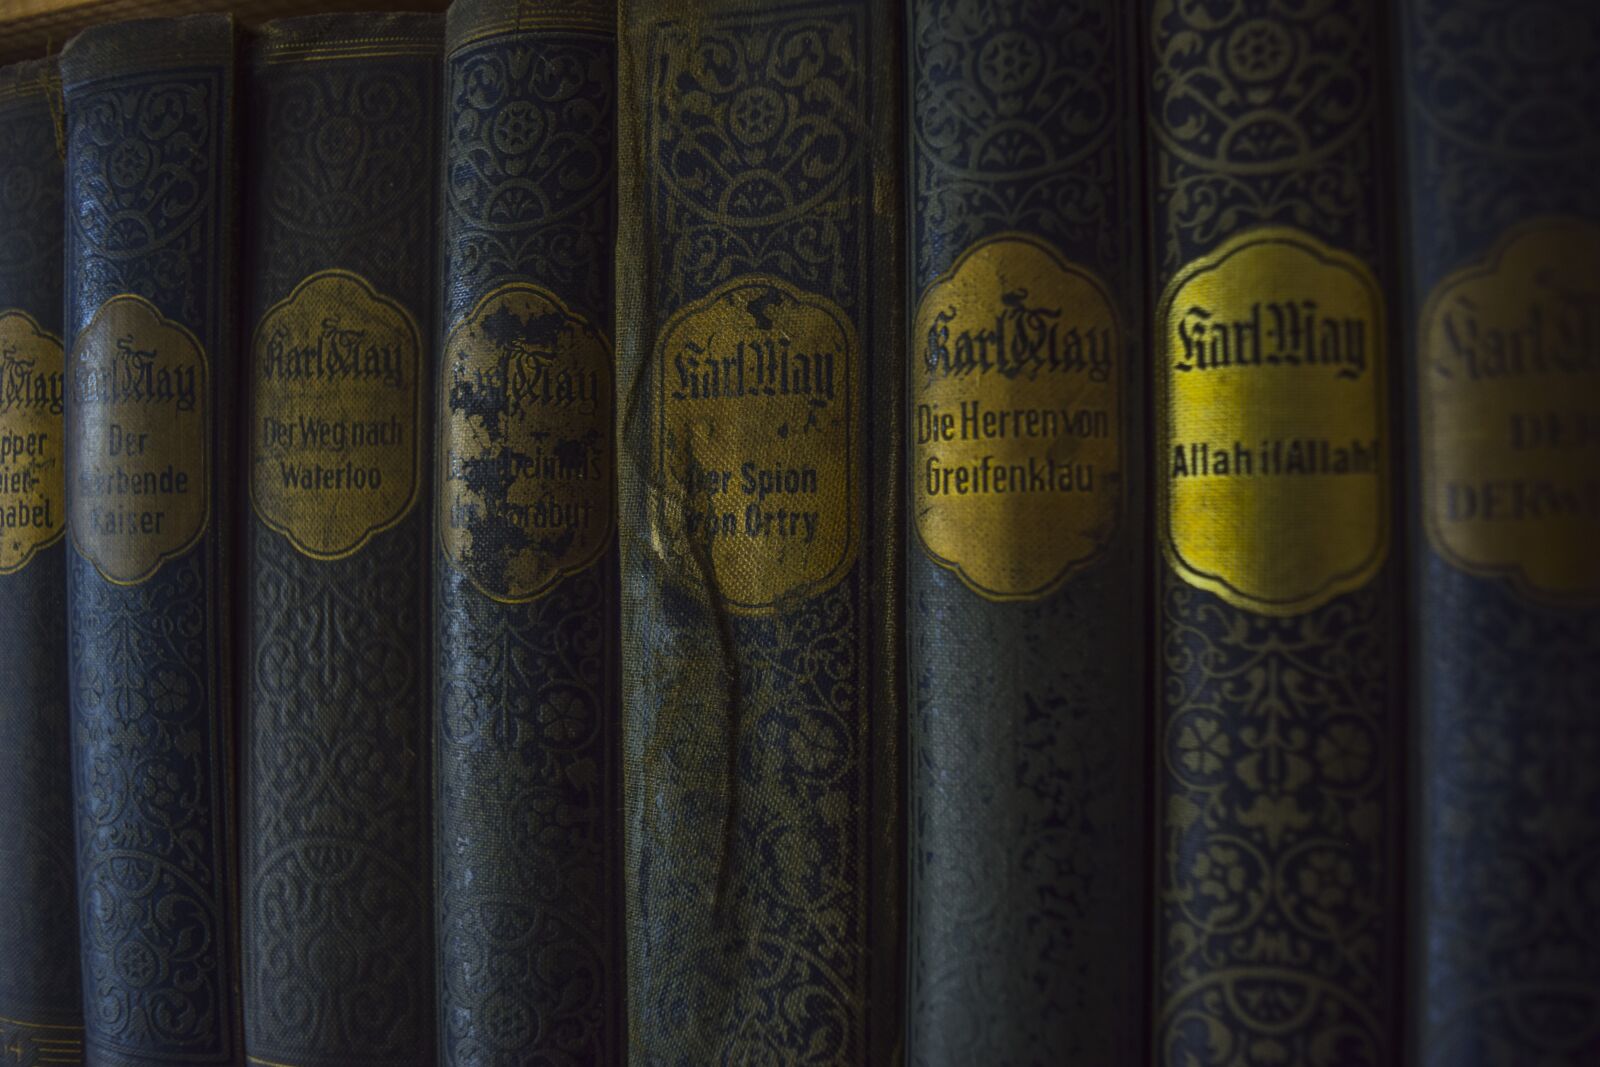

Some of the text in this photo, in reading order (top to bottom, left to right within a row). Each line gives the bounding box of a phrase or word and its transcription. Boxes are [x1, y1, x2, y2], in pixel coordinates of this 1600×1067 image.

[263, 323, 324, 380] Karl
[320, 316, 404, 388] May
[922, 287, 1114, 383] Karl May
[1172, 299, 1367, 380] Karl May
[671, 337, 834, 408] Karl May
[109, 424, 149, 456] Der
[264, 414, 403, 452] Der Weg nach
[916, 401, 1110, 445] Die Herren von
[279, 460, 382, 490] Waterloo
[925, 455, 1094, 497] Greifenklau
[1171, 441, 1253, 478] Allah
[741, 460, 817, 501] Spion
[745, 503, 820, 544] Ortry
